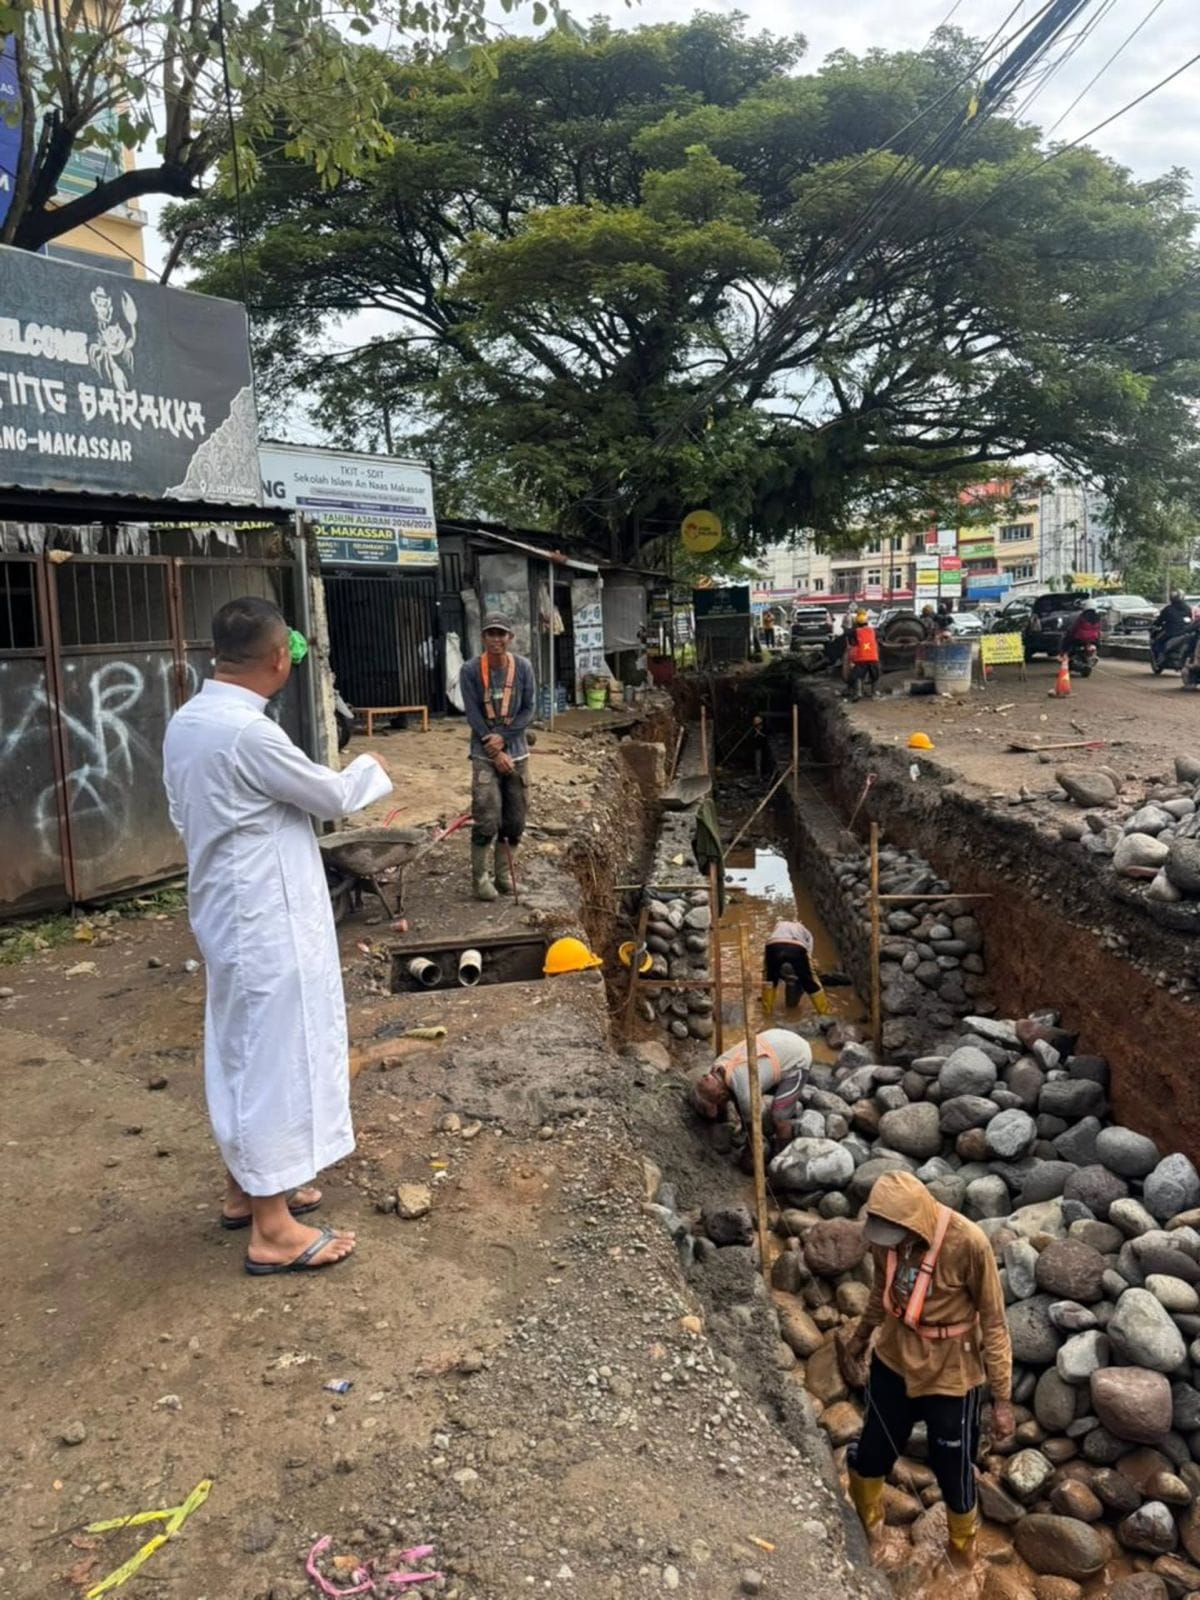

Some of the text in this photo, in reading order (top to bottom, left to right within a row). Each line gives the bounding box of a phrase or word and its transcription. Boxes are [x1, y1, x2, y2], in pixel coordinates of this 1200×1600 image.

[78, 382, 206, 440] BARAKKA
[0, 425, 132, 462] NG-MAKASSAR
[293, 472, 426, 494] Sekolah Islam An Naas Makassar
[331, 526, 393, 540] MAKASSAR
